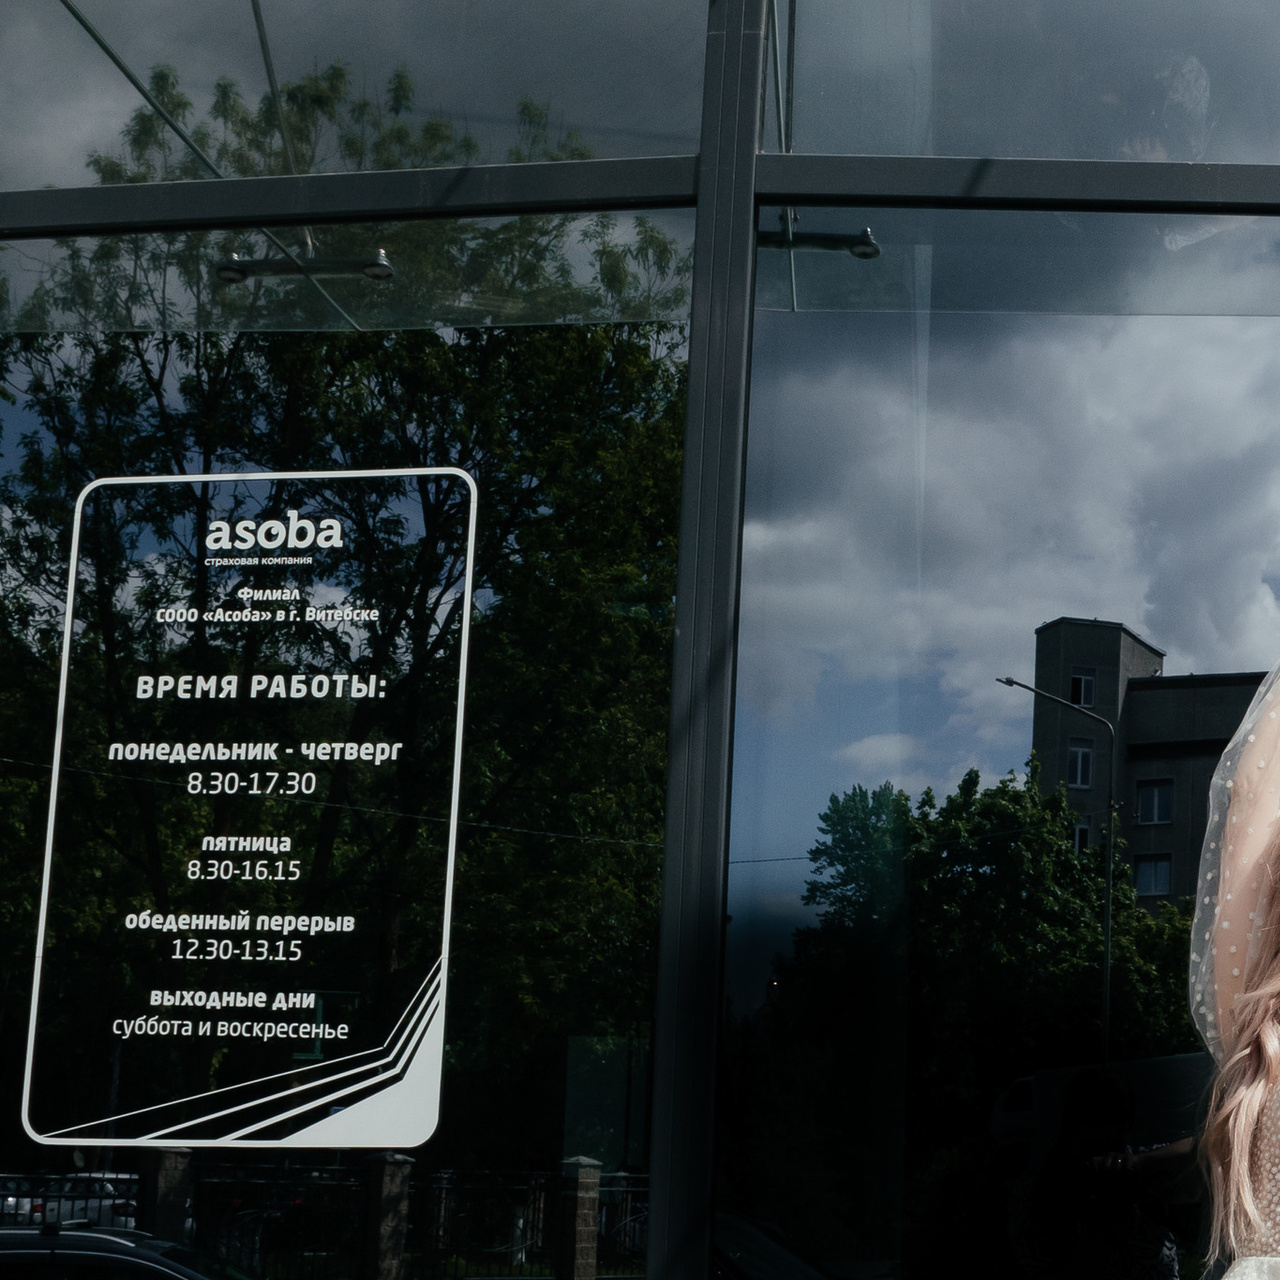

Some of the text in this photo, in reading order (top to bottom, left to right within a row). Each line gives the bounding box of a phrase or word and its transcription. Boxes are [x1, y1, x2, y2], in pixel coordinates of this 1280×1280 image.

[205, 509, 344, 550] asoba
[204, 556, 313, 567] страховая компания
[237, 586, 301, 602] Филиал
[155, 606, 380, 623] СООО «Асоба» в г. Витебске
[136, 674, 386, 699] ВРЕМЯ РАБОТЫ:
[108, 742, 279, 764] понедельник
[301, 742, 403, 766] четверг
[187, 771, 316, 795] 8.30-17.30
[201, 836, 291, 855] пятница
[187, 859, 301, 881] 8.30-16.15
[125, 909, 355, 936] обеденный перерыв
[171, 938, 302, 961] 12.30-13.15
[150, 990, 316, 1011] выходные дни
[112, 1015, 349, 1042] суббота и воскресенье
